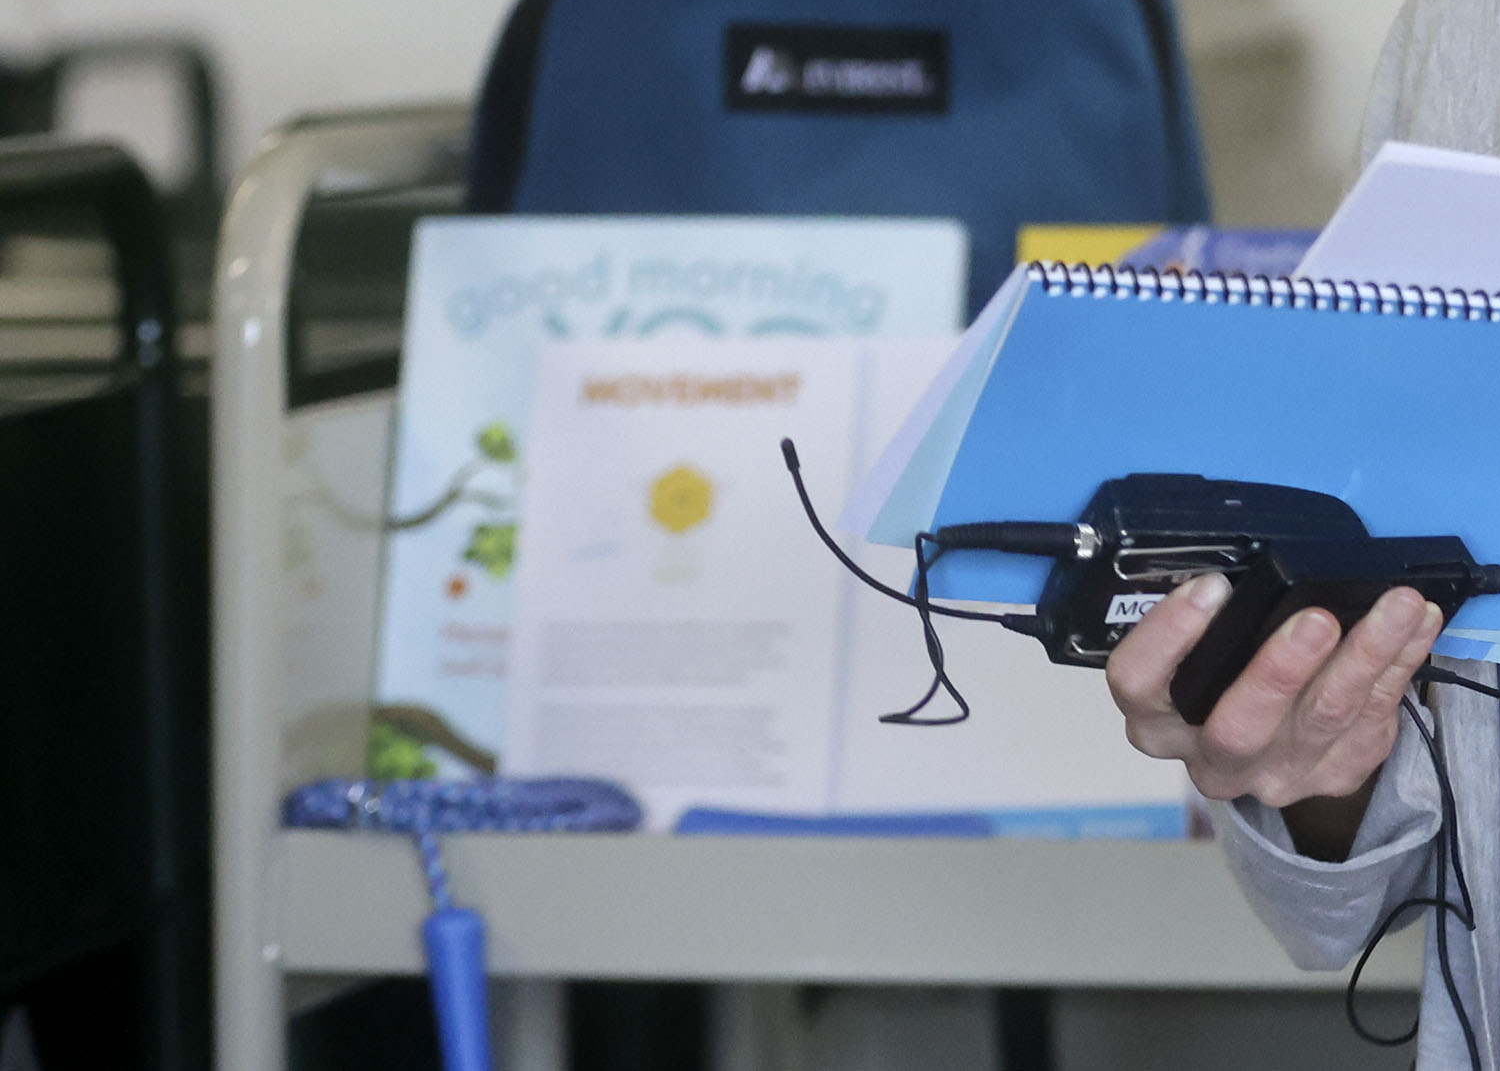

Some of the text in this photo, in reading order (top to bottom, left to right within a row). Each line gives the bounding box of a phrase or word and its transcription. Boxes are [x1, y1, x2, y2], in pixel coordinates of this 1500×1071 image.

[444, 249, 888, 341] good morning
[579, 371, 804, 406] MOVEMENT
